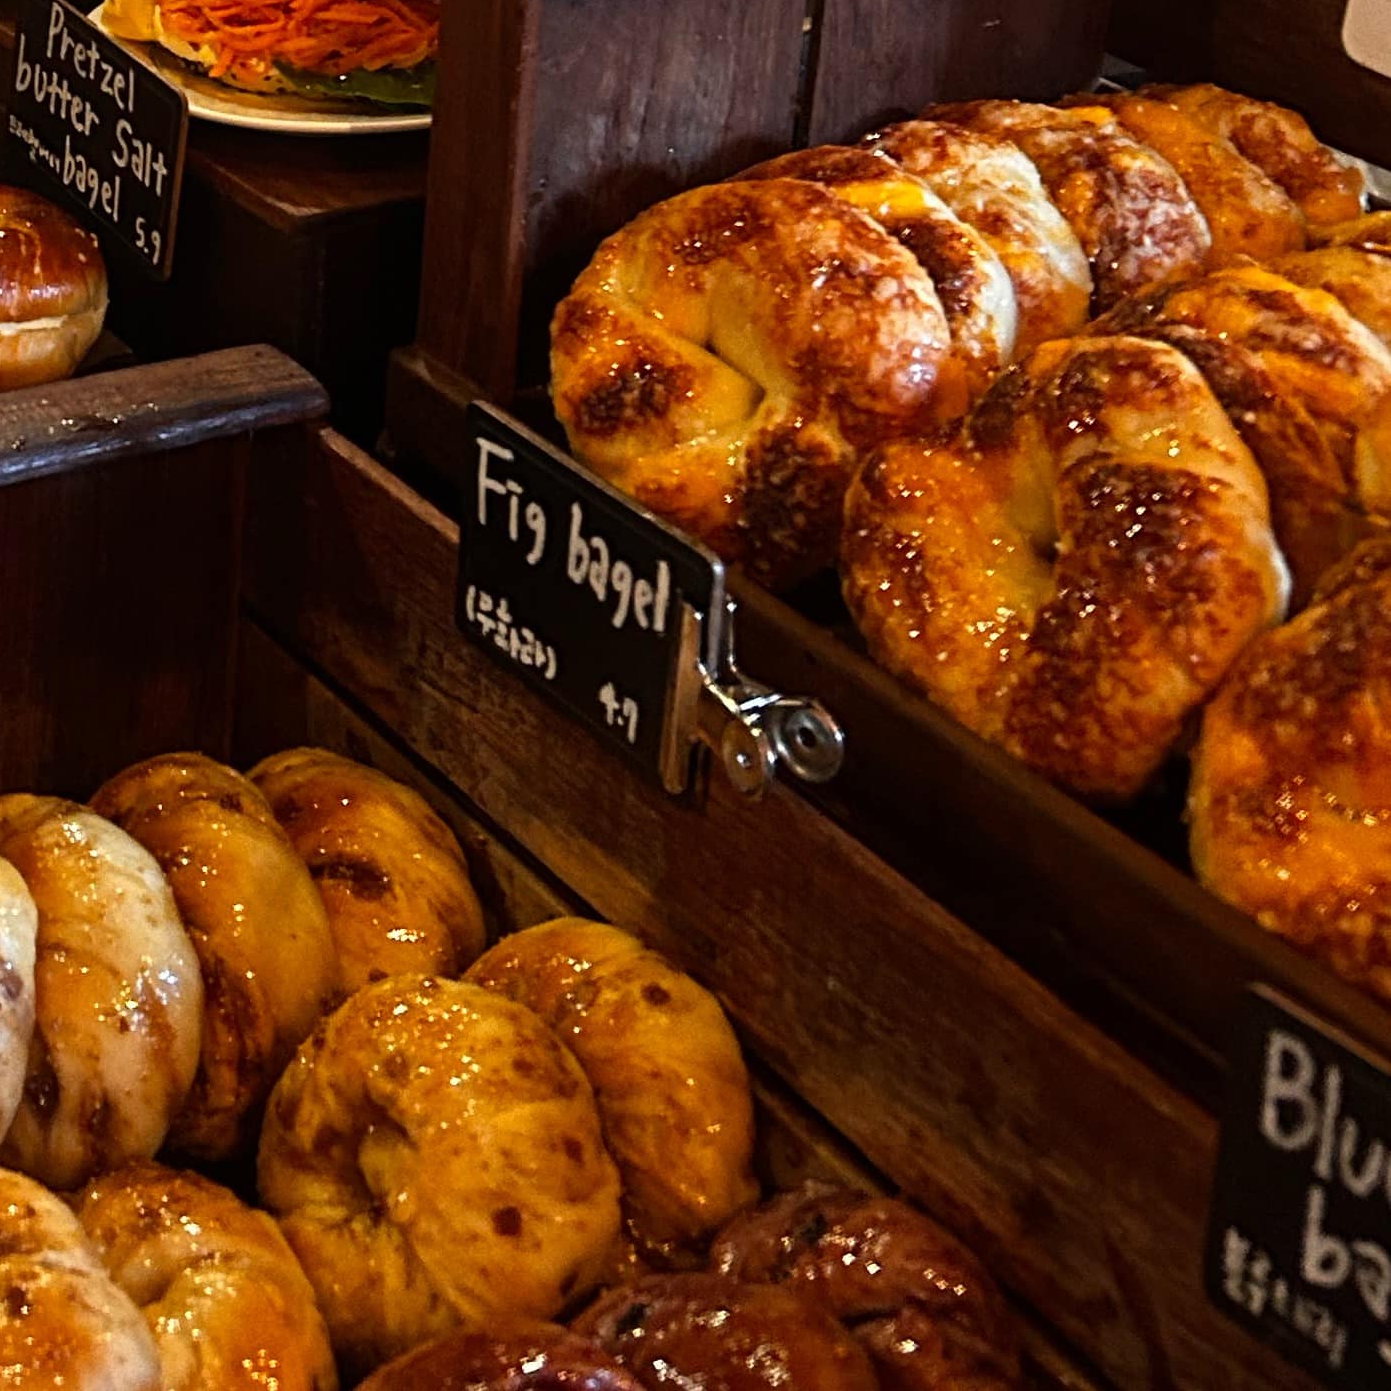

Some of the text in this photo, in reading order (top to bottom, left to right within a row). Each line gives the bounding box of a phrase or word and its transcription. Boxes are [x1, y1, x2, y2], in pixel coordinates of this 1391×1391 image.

[14, 32, 101, 137] butter
[111, 117, 170, 197] Salt
[46, 0, 136, 114] Pretzel
[62, 133, 122, 223] bagel
[476, 436, 672, 635] Fig bagel
[1260, 1027, 1391, 1199] Blu
